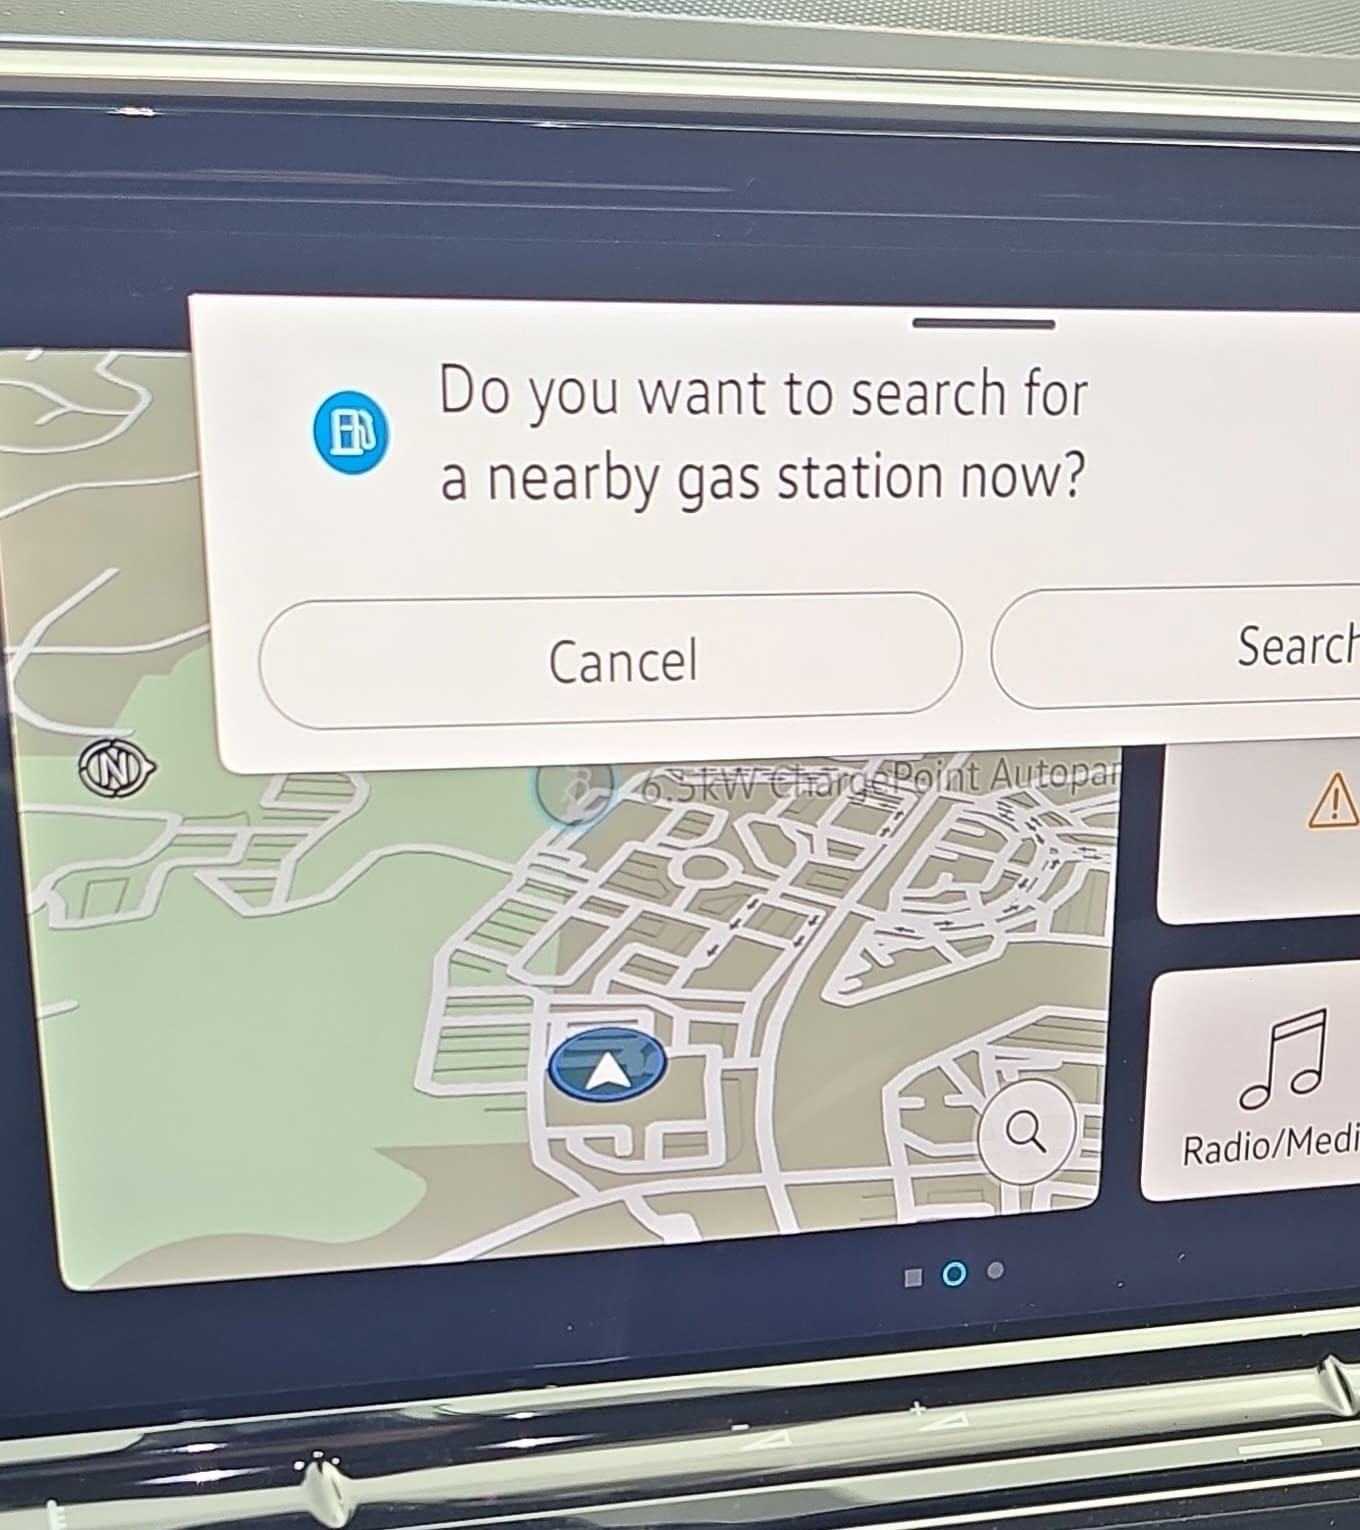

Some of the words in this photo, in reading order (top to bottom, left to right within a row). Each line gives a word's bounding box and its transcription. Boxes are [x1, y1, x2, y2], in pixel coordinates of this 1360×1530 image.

[440, 363, 510, 414] Do
[528, 376, 618, 428] you
[638, 372, 767, 415] want
[783, 372, 833, 415] to
[851, 366, 1006, 416] search
[1023, 366, 1089, 416] for
[441, 463, 468, 501] a
[489, 449, 660, 514] nearby
[677, 463, 761, 514] gas
[777, 450, 943, 500] station
[961, 449, 1086, 499] now?
[549, 636, 698, 684] Cancel
